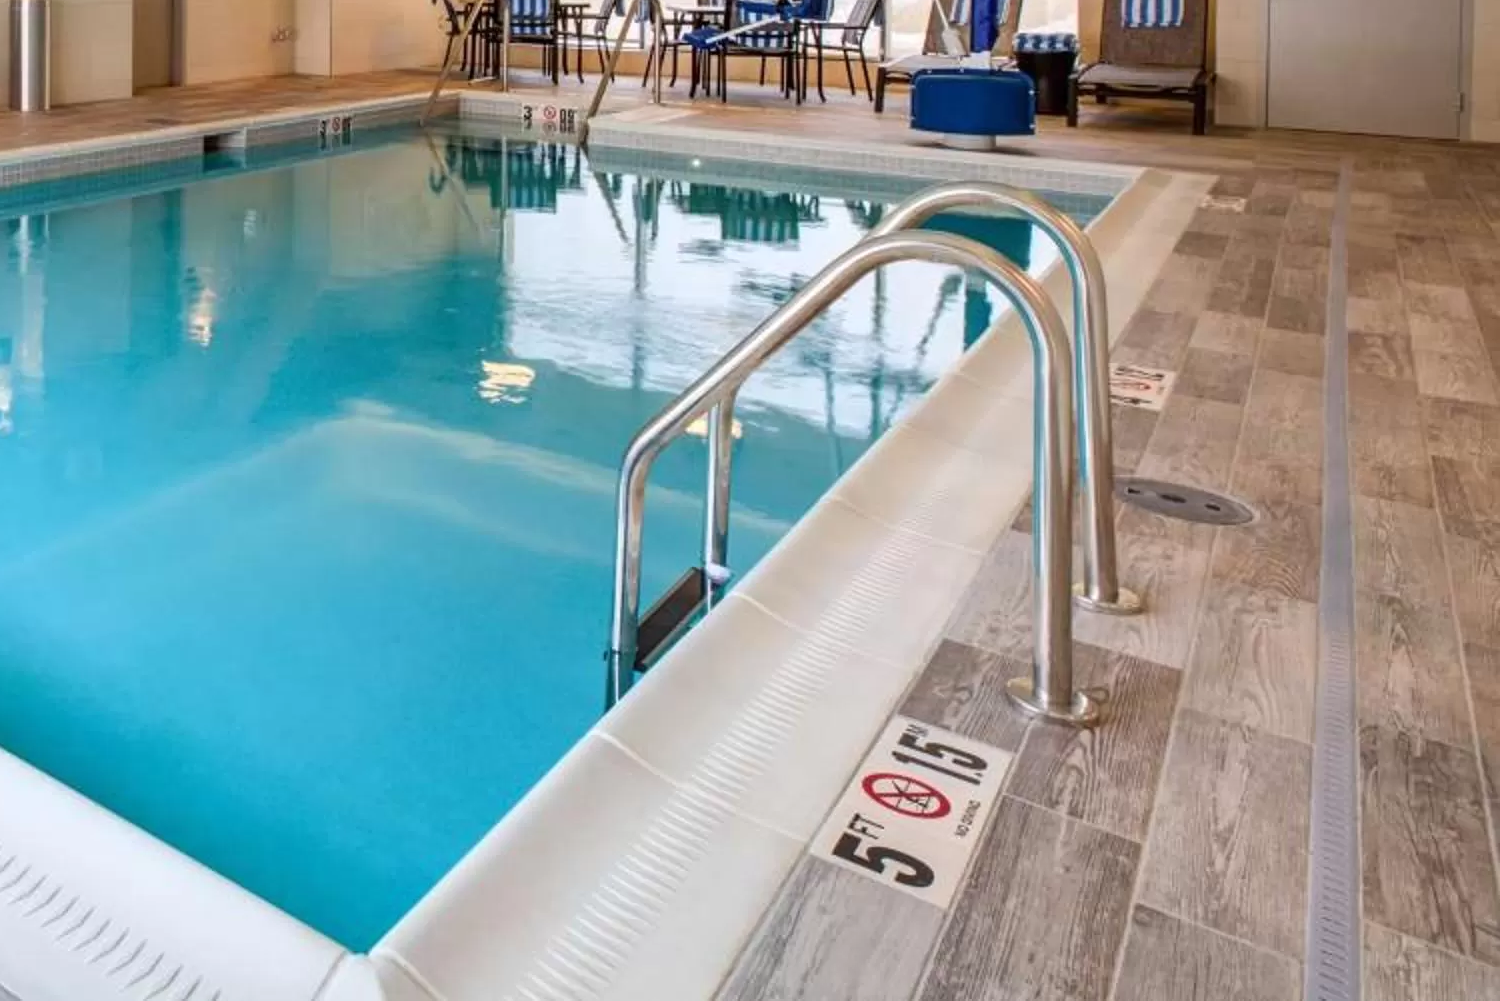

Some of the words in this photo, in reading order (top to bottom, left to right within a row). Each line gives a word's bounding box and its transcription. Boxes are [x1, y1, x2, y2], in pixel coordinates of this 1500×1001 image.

[523, 105, 533, 120] 3
[846, 811, 886, 841] FT
[831, 830, 936, 889] 5
